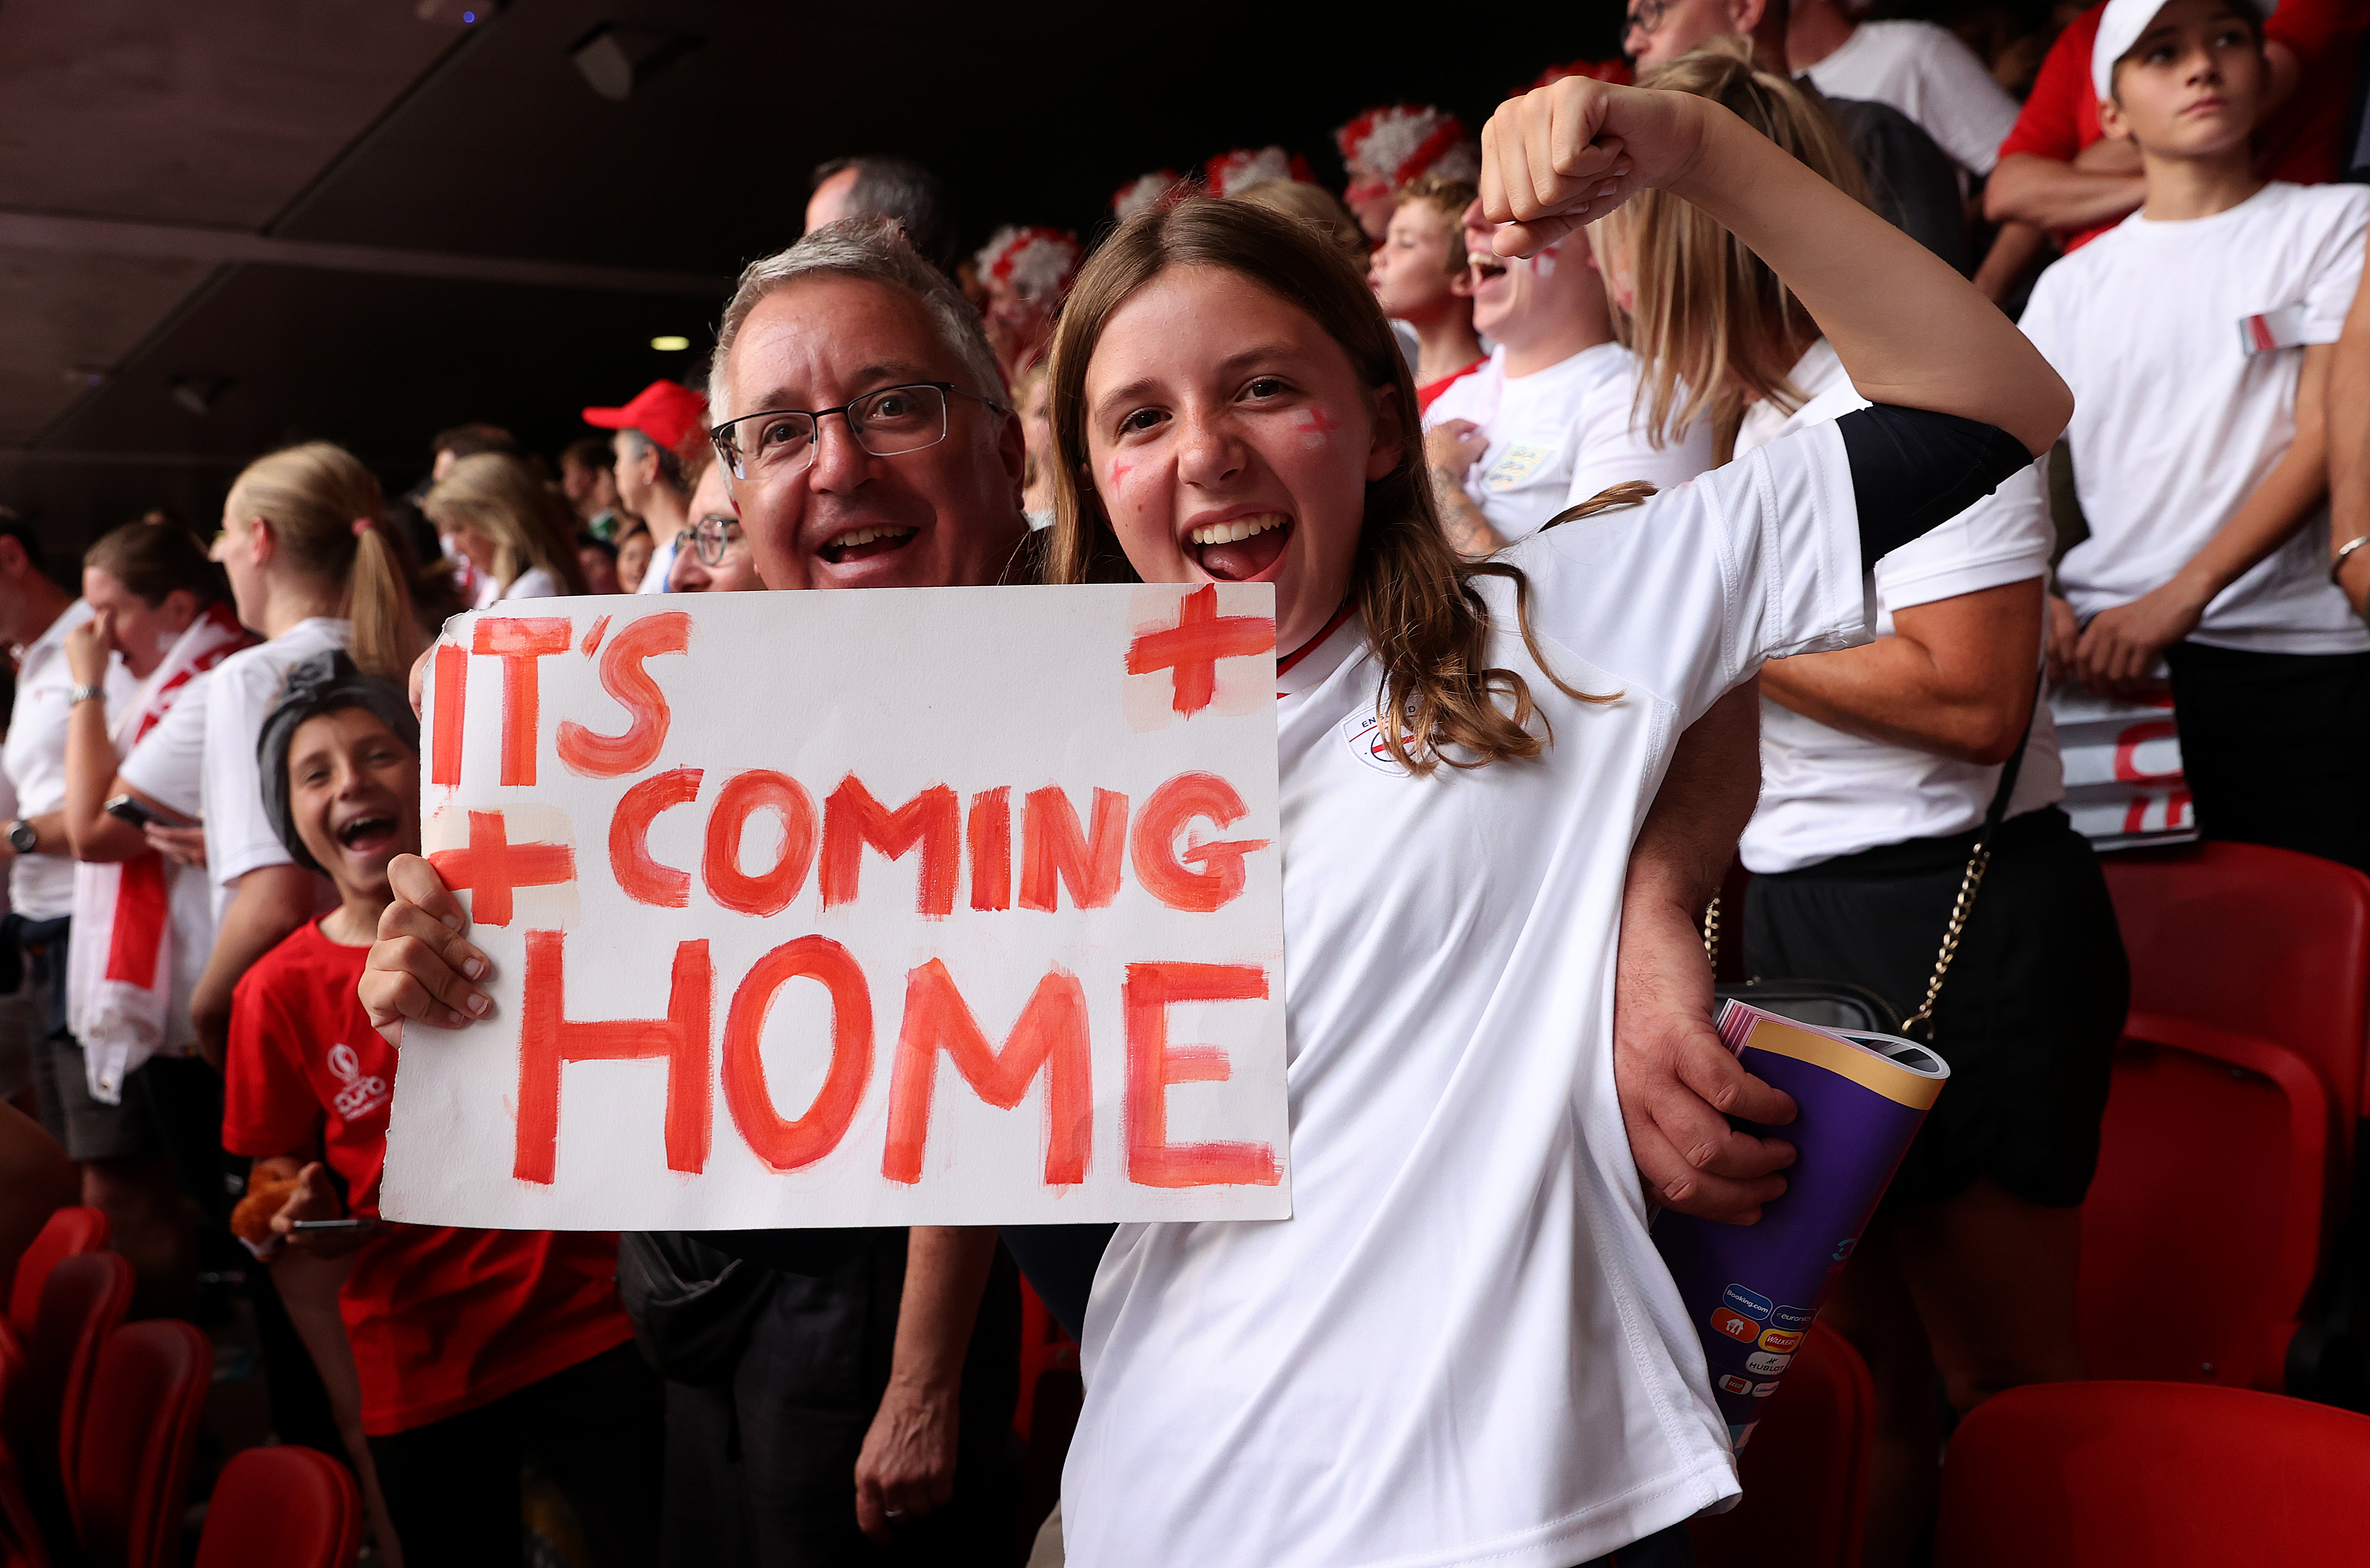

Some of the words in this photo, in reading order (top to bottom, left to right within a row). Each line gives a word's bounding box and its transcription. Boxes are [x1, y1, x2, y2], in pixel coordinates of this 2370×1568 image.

[431, 611, 692, 788] IT'S
[609, 767, 1272, 922] COMING
[513, 929, 1284, 1188] HOME
[1726, 1290, 1768, 1313] Booking.com
[1767, 1336, 1797, 1345] WALKERS
[1749, 1362, 1785, 1372] HUBLOT
